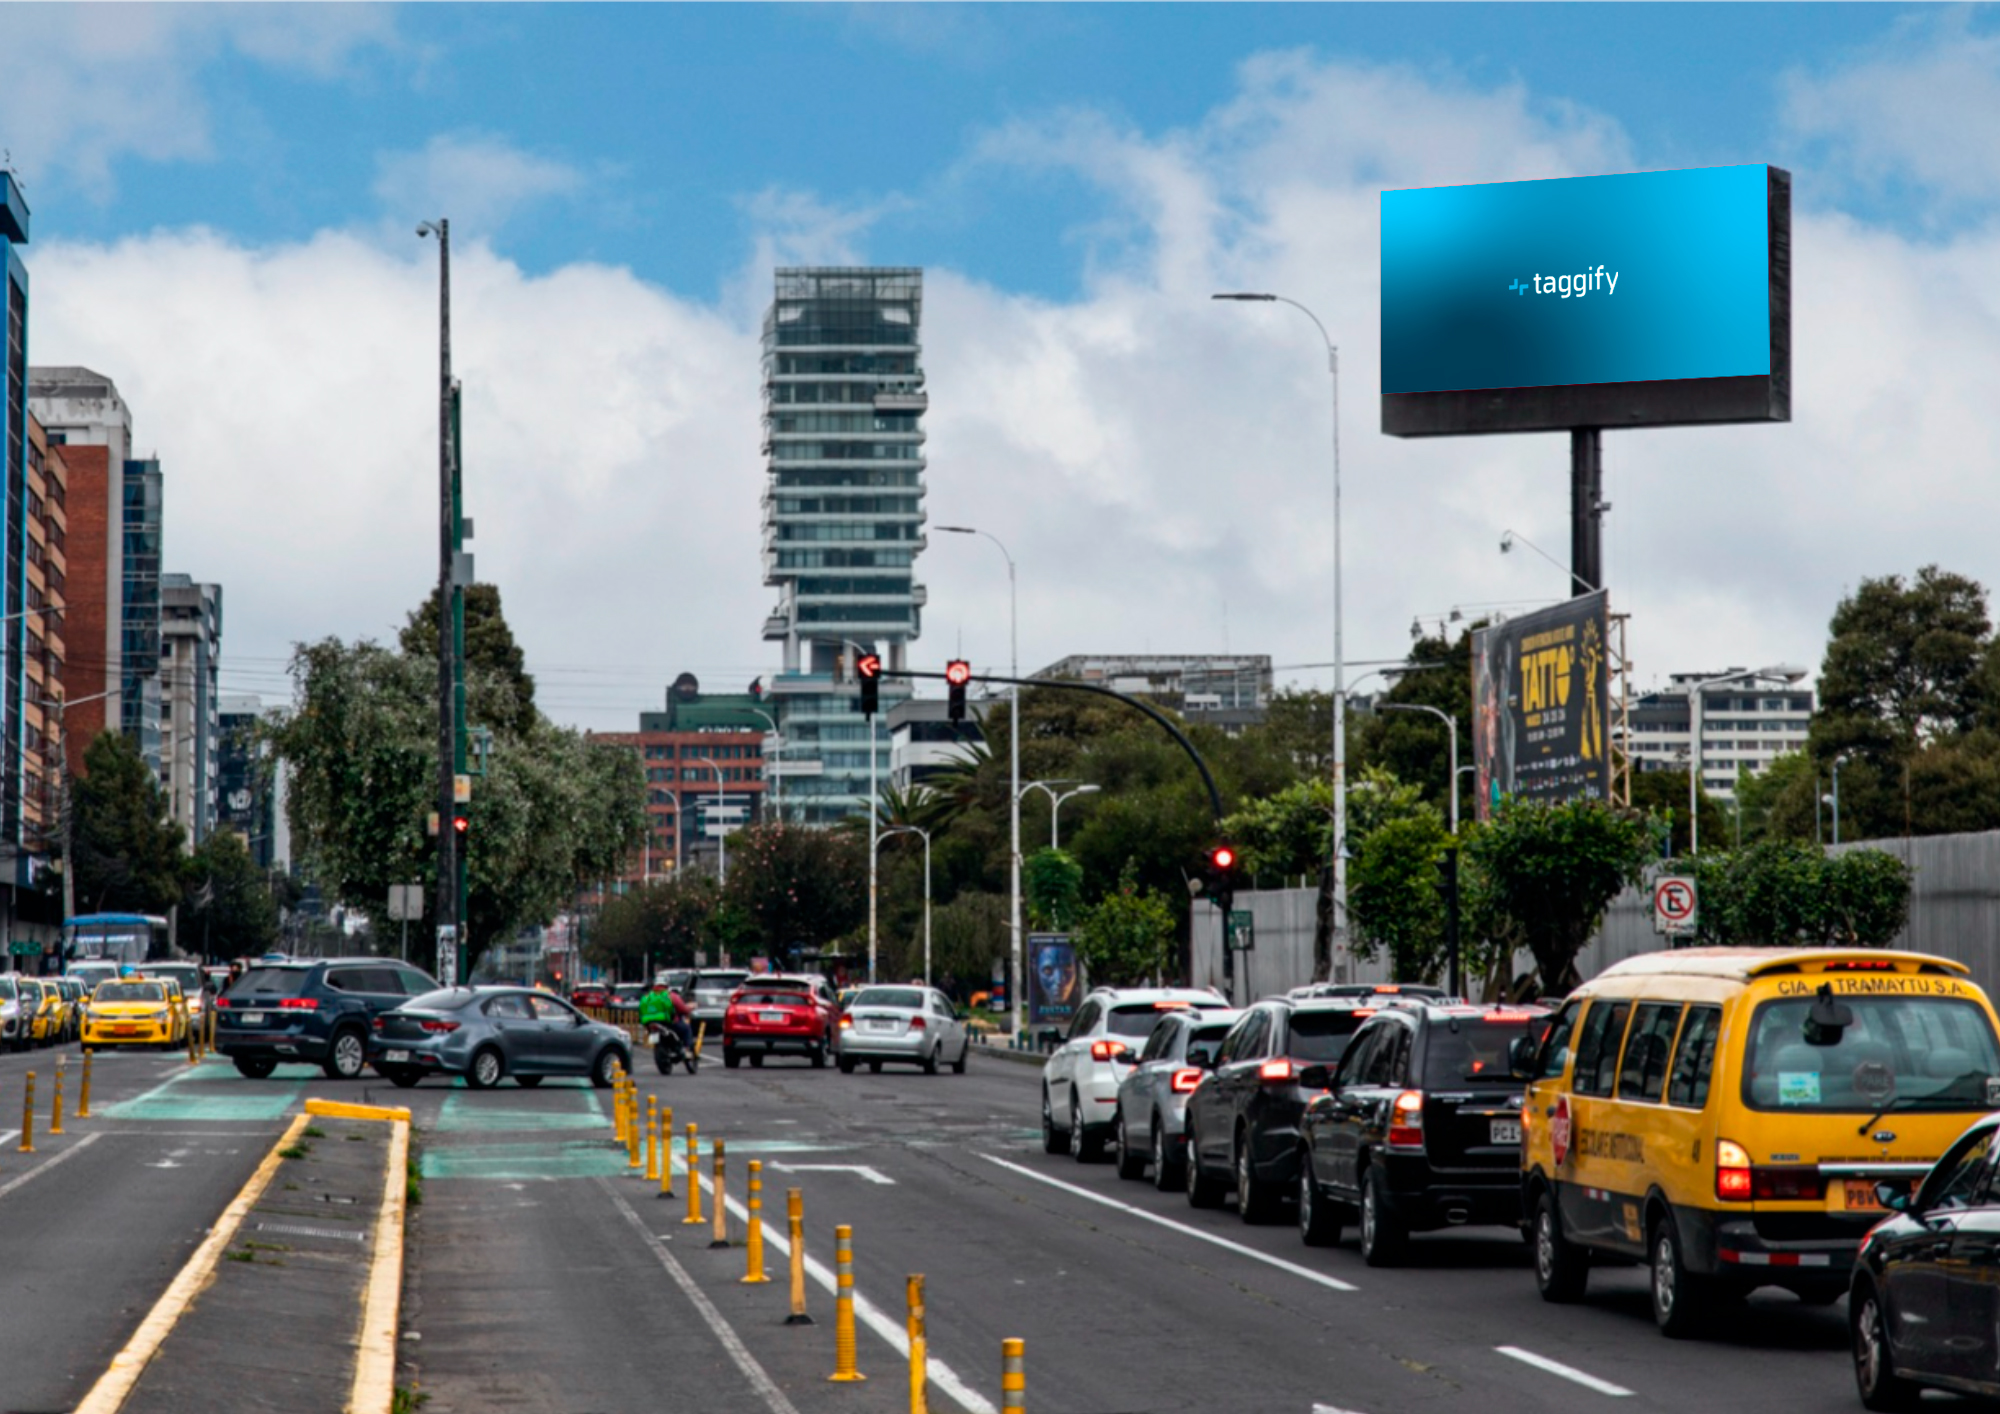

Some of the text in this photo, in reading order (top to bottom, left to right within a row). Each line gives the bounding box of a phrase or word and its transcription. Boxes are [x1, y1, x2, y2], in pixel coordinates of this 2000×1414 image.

[1533, 264, 1619, 299] taggify
[1777, 978, 1968, 996] CIA. TRAMAYTU S.A.
